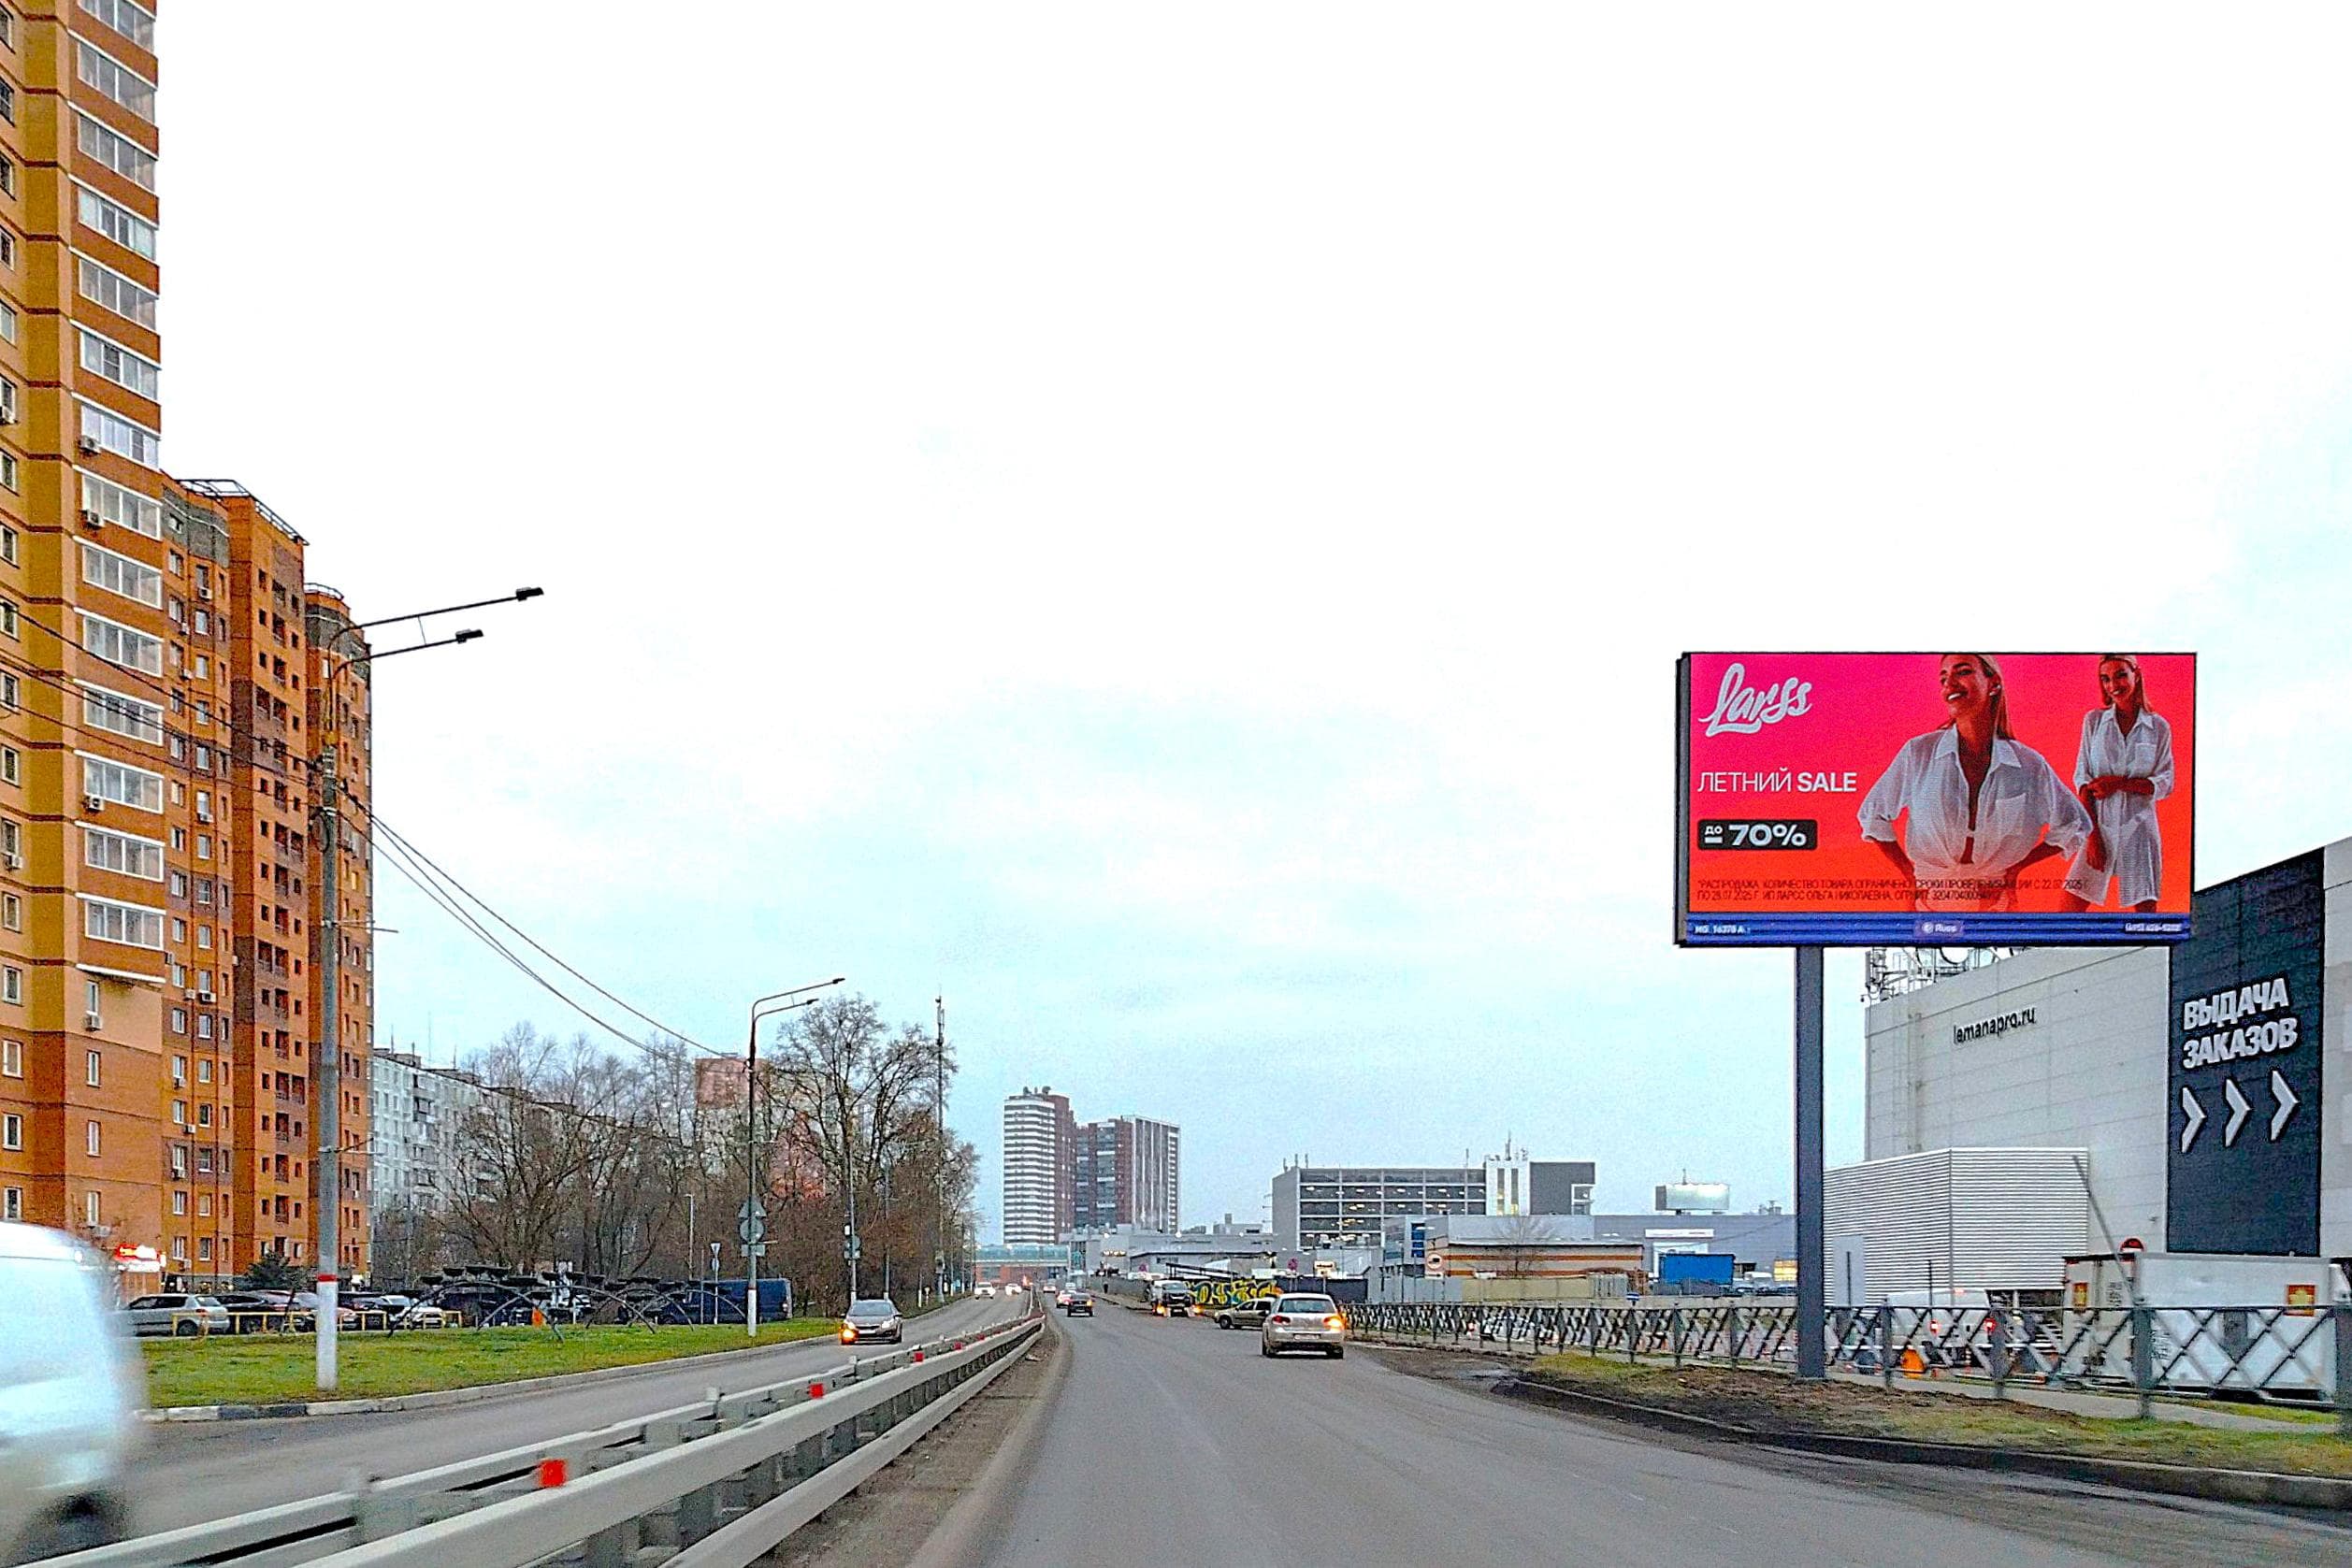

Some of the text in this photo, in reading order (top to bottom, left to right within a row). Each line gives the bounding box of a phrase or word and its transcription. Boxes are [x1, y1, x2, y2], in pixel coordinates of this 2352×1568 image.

[1697, 767, 1858, 793] ЛЕТНИЙ SALE
[1954, 1007, 2037, 1045] lemanapro.ru
[2183, 978, 2290, 1031] ВЫДАЧА
[2183, 1016, 2299, 1070] ЗАКАЗОВ
